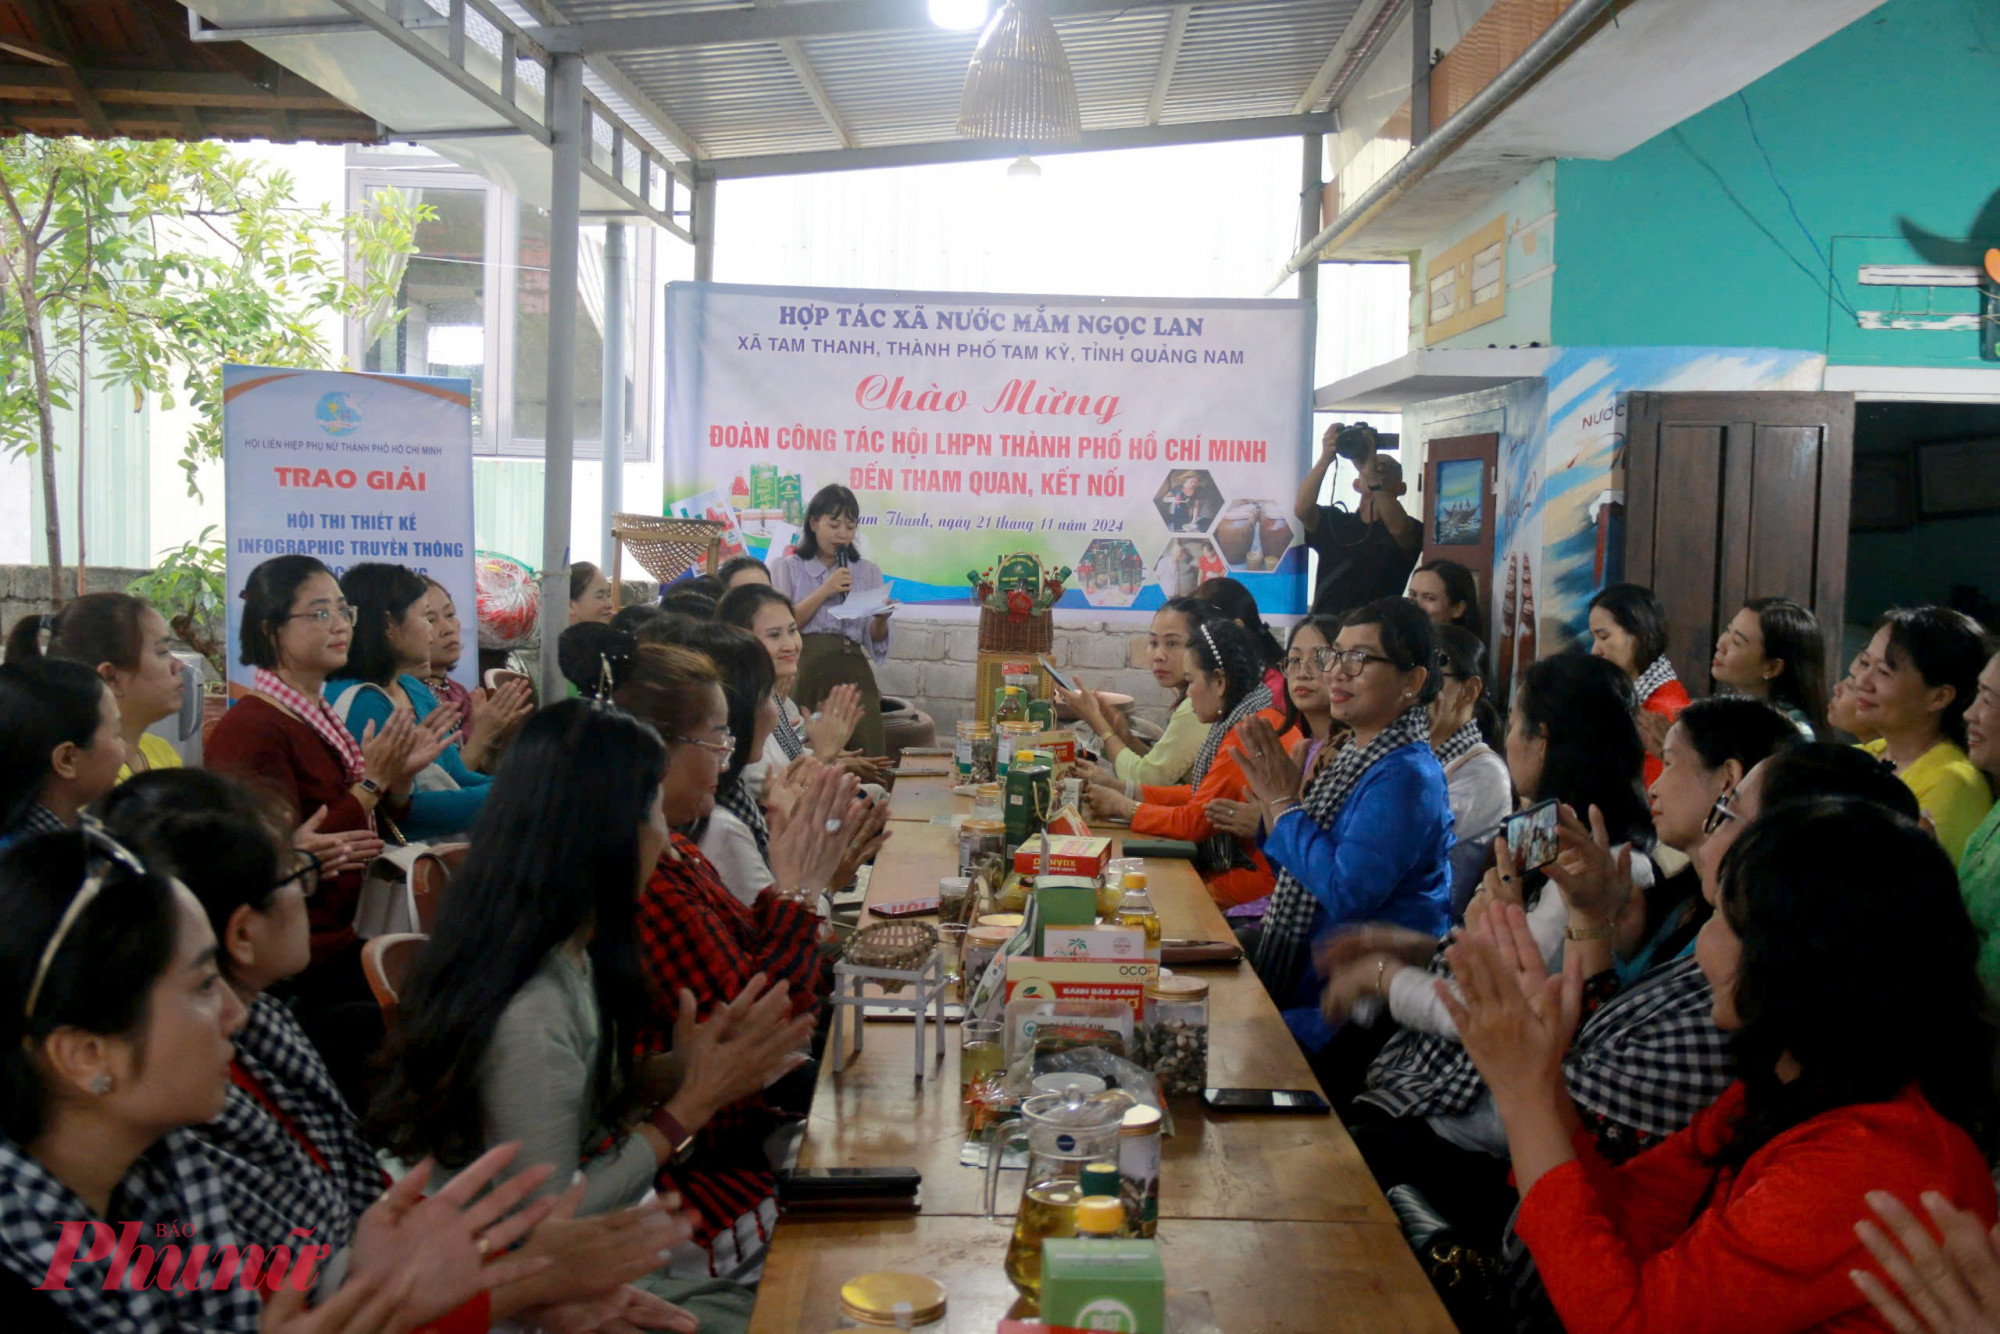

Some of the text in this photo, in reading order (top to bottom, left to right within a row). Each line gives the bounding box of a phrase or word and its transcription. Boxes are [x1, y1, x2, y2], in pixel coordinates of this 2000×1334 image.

[779, 302, 1204, 340] HỢP TÁC XÃ NƯỚC MẮM NGỌC LAN
[738, 333, 1244, 365] XÃ TAM THANH, THÀNH PHỐ TAM KỲ, TỈNH QUẢNG NAM
[855, 373, 1121, 425] Chào Mừng
[1582, 402, 1626, 430] NƯỚC
[421, 446, 442, 456] MINH
[709, 421, 1267, 463] ĐOÀN CÔNG TÁC HỘI LHPN THÀNH PHỐ HỒ CHÍ MINH
[273, 465, 426, 491] TRAO GIẢI
[850, 461, 1124, 497] ĐẾN THAM QUAN, KẾT NỐI
[287, 510, 417, 532] HỘI THI THIẾT KẾ
[856, 511, 1124, 533] am Thanh, ngày 21 tháng 11 năm 2024
[238, 535, 464, 558] INFOGRAPHIC TRUYỀN THÔNG
[1119, 966, 1155, 976] OCOP
[1113, 988, 1140, 997] XANH
